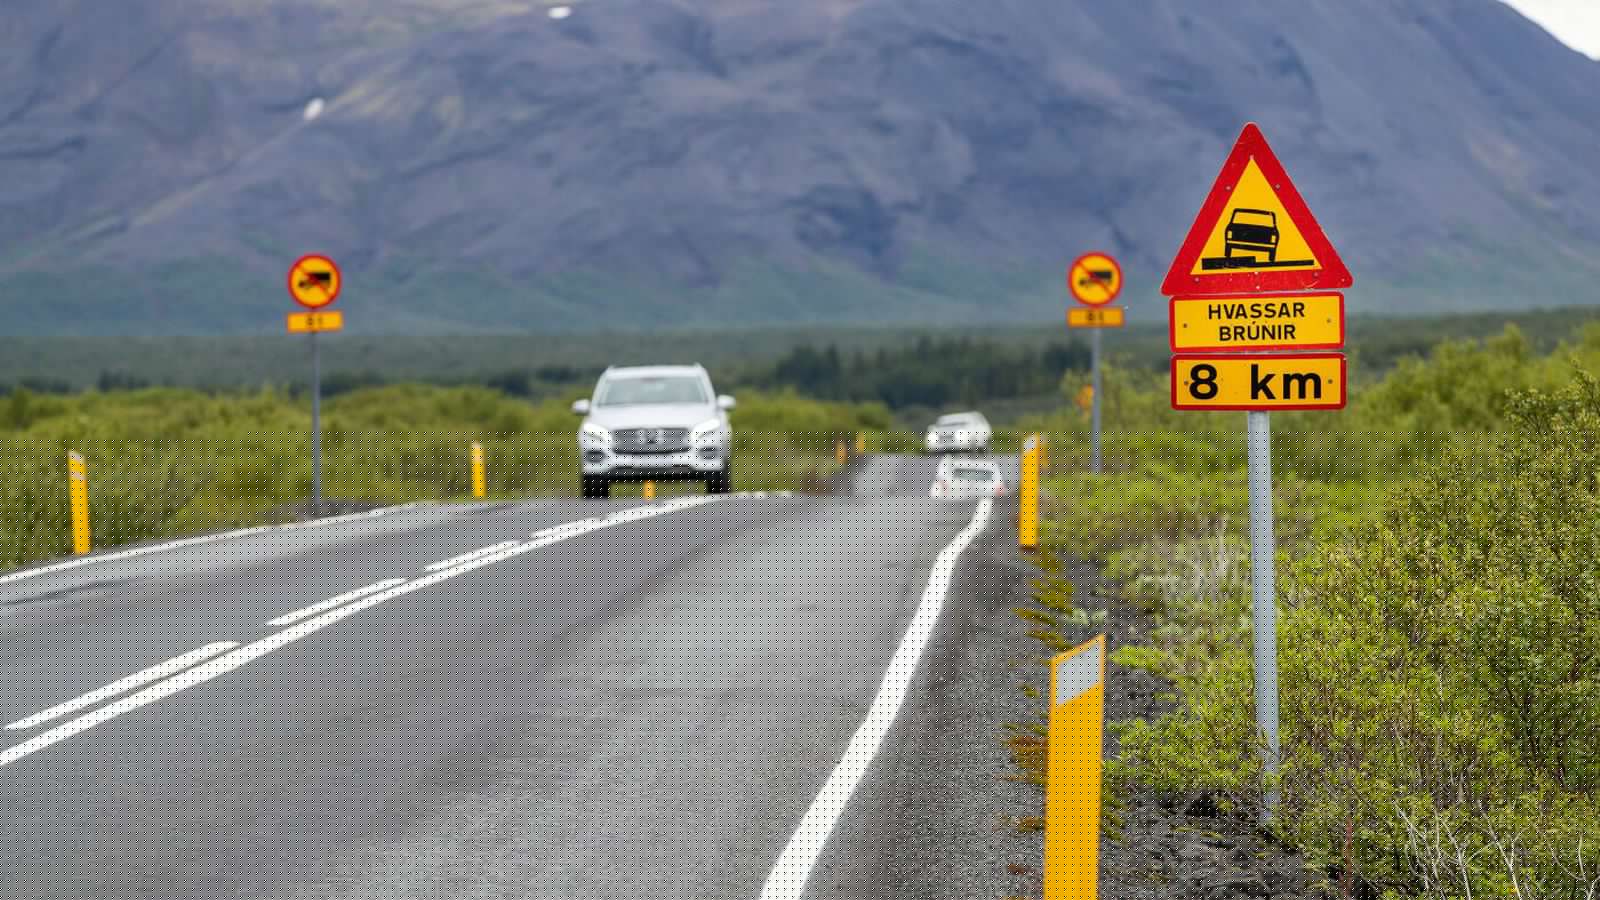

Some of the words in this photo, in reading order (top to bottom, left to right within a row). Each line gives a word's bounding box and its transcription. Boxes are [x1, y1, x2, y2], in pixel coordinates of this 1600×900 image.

[1208, 302, 1305, 320] HVASSAR
[1219, 321, 1296, 341] BRÚNIR
[1189, 363, 1219, 400] 8
[1250, 363, 1322, 400] km
